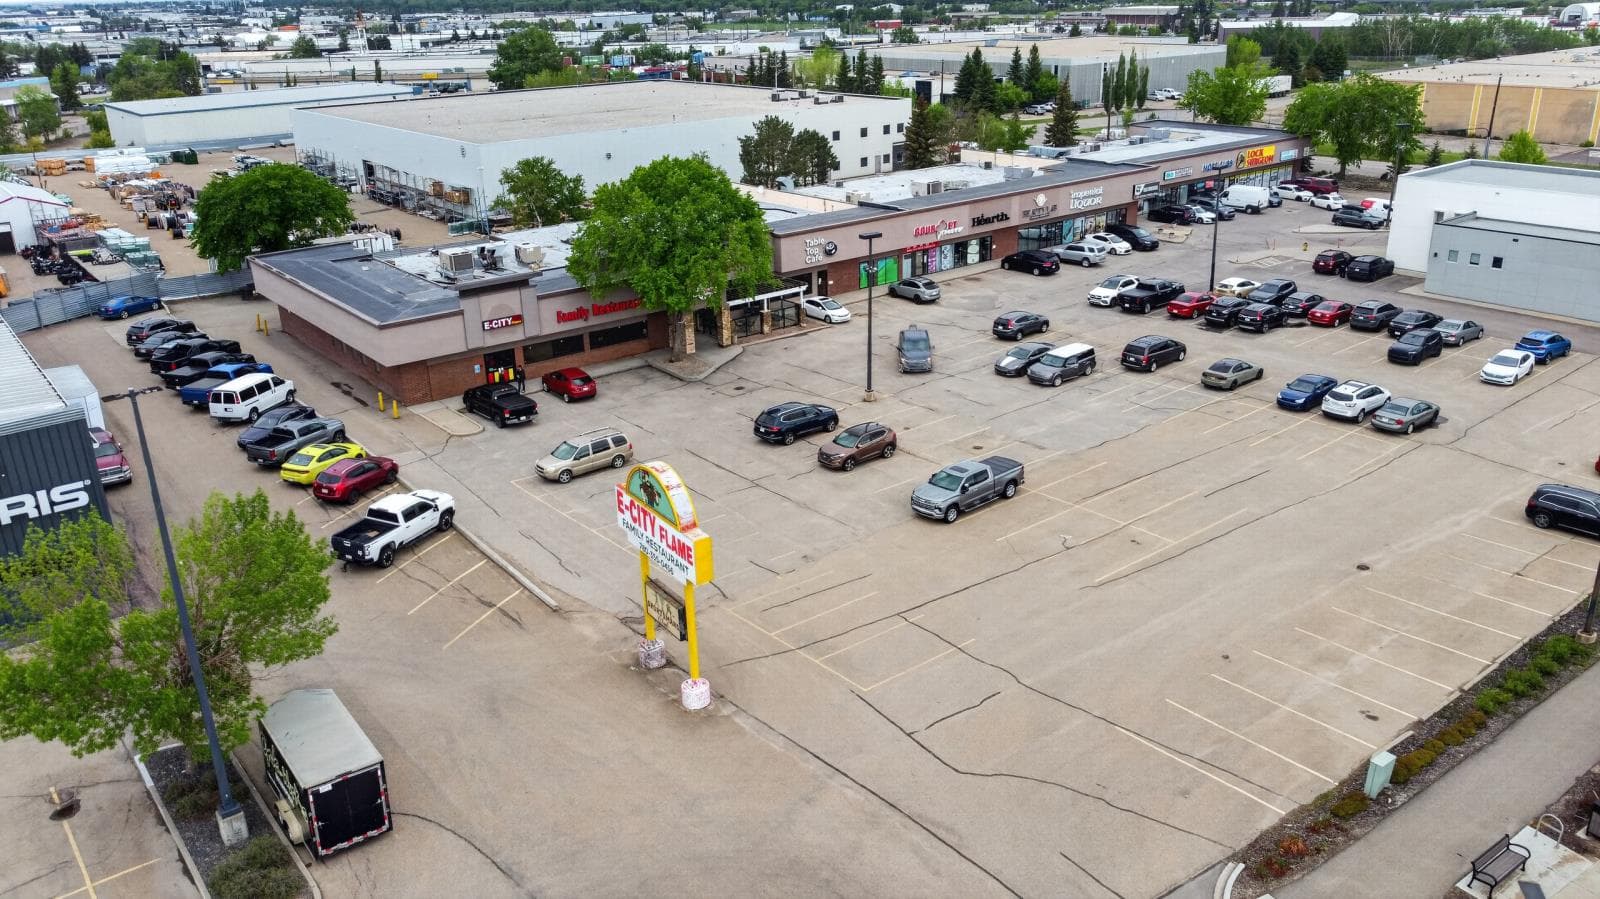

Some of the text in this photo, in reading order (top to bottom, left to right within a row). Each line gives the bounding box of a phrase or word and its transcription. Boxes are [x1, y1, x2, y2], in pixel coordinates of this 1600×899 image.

[1248, 149, 1264, 158] LOCK
[806, 237, 825, 247] Table
[806, 247, 819, 255] Top
[484, 317, 512, 330] E-CITY
[617, 489, 693, 566] E-CITY FLAME
[622, 518, 644, 540] FAMILY
[645, 535, 689, 576] RESTAURANT
